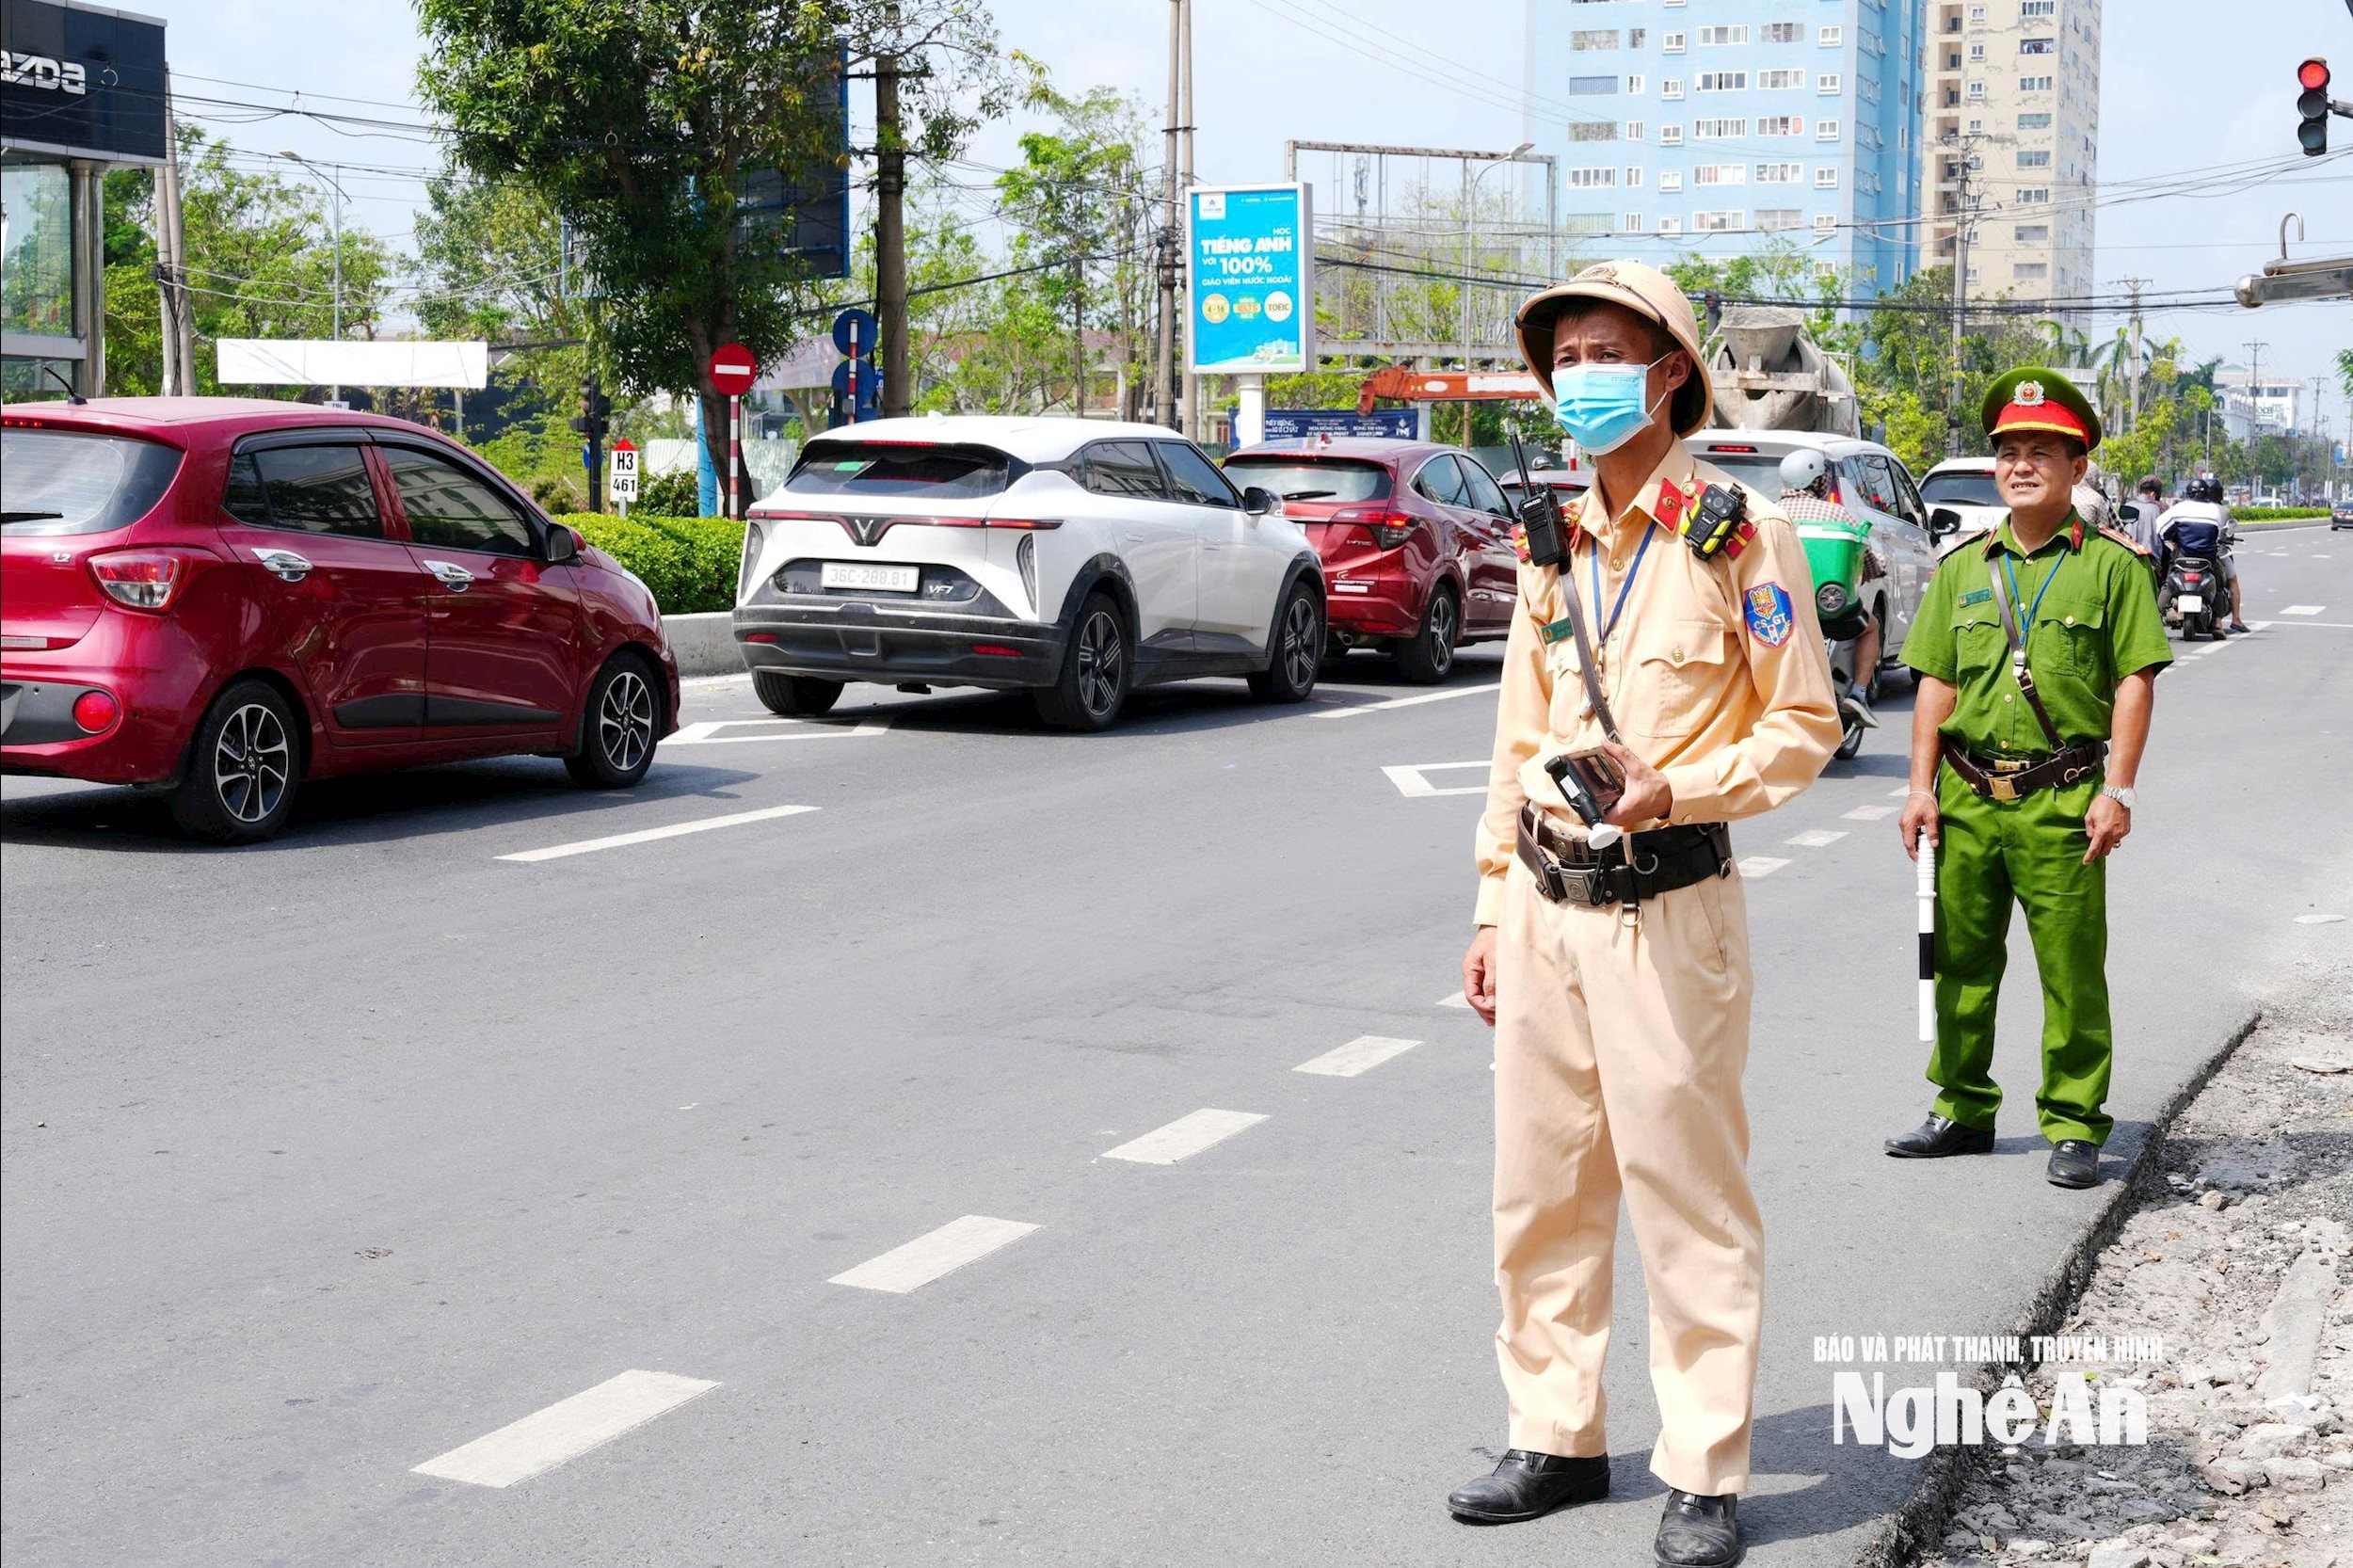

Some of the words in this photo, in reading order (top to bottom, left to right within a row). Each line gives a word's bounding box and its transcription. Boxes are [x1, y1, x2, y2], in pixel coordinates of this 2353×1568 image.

[1201, 234, 1253, 255] TIẾNG
[1254, 236, 1292, 252] ANH
[1220, 256, 1273, 275] 100%
[1268, 303, 1290, 312] TOEIC
[616, 452, 633, 470] H3
[613, 478, 635, 492] 461
[928, 584, 954, 595] VF7
